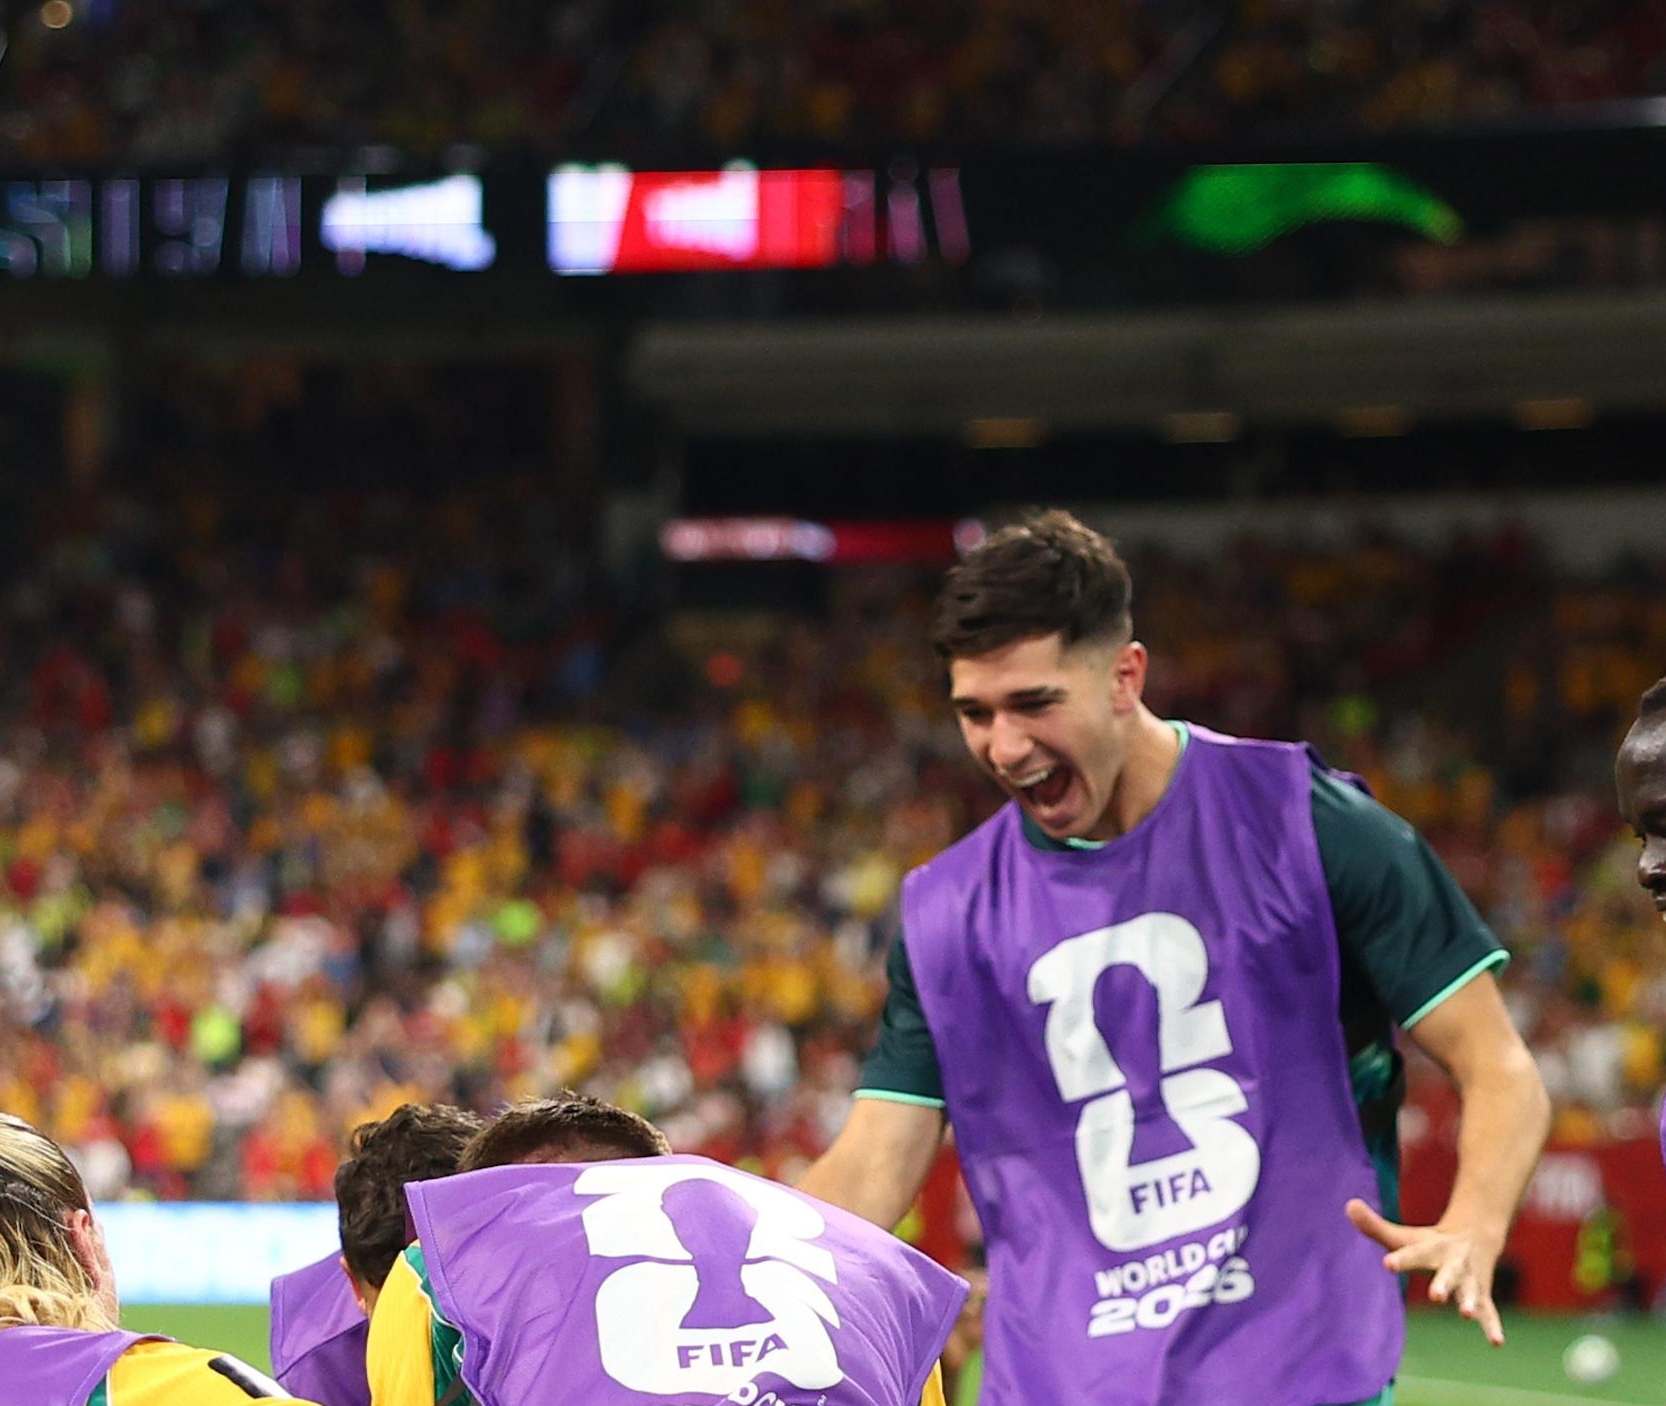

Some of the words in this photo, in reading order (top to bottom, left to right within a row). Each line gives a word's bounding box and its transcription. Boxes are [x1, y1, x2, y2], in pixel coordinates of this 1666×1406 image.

[1129, 1168, 1212, 1215] FIFA
[1094, 1242, 1206, 1298] WORLD
[1087, 1256, 1256, 1339] 2026
[676, 1332, 789, 1370] FIFA
